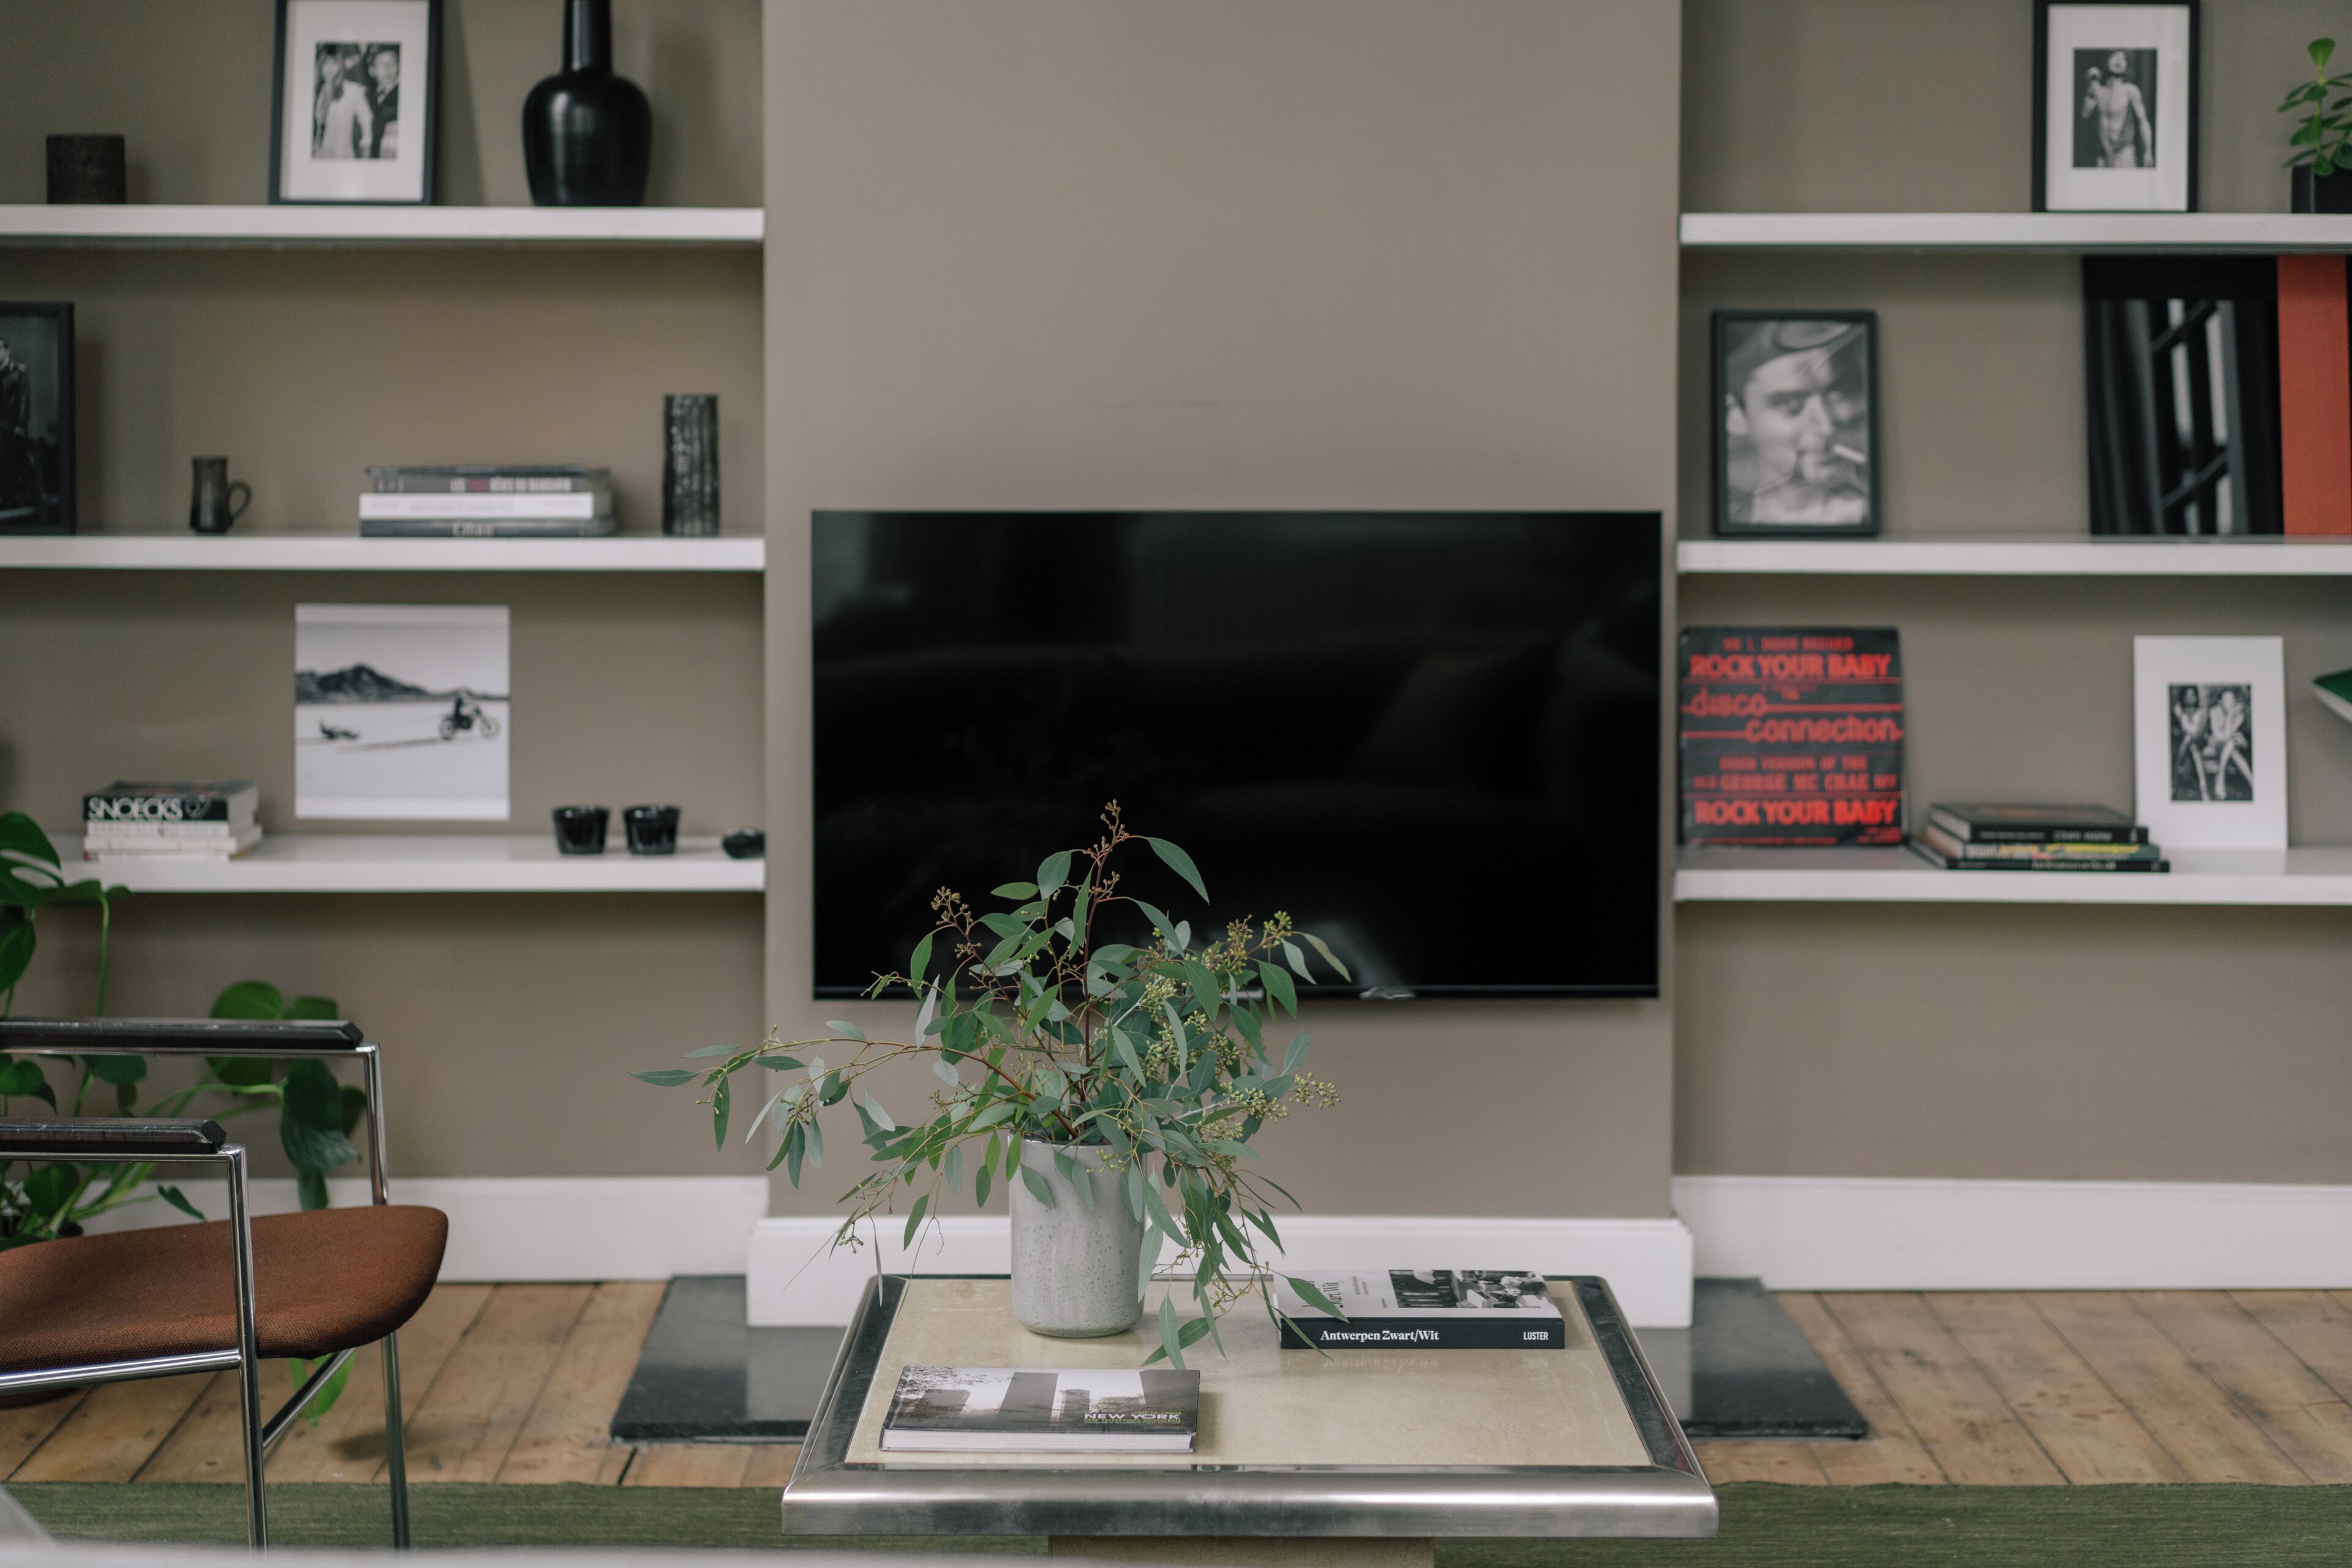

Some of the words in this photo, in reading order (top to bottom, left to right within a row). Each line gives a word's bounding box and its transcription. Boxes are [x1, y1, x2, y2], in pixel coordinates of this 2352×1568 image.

[1689, 654, 1757, 677] ROCK
[1758, 654, 1823, 677] YOUR
[1828, 654, 1891, 677] BABY
[1691, 687, 1767, 717] disco
[1745, 715, 1898, 742] connection
[88, 797, 183, 821] SNOECKS
[1694, 800, 1759, 824] ROCK
[1763, 800, 1829, 824] YOUR
[1832, 800, 1898, 824] BABY
[1321, 1330, 1381, 1341] Antwerpen
[1382, 1330, 1439, 1342] Zwart/Wit
[1523, 1332, 1549, 1341] LUSTER
